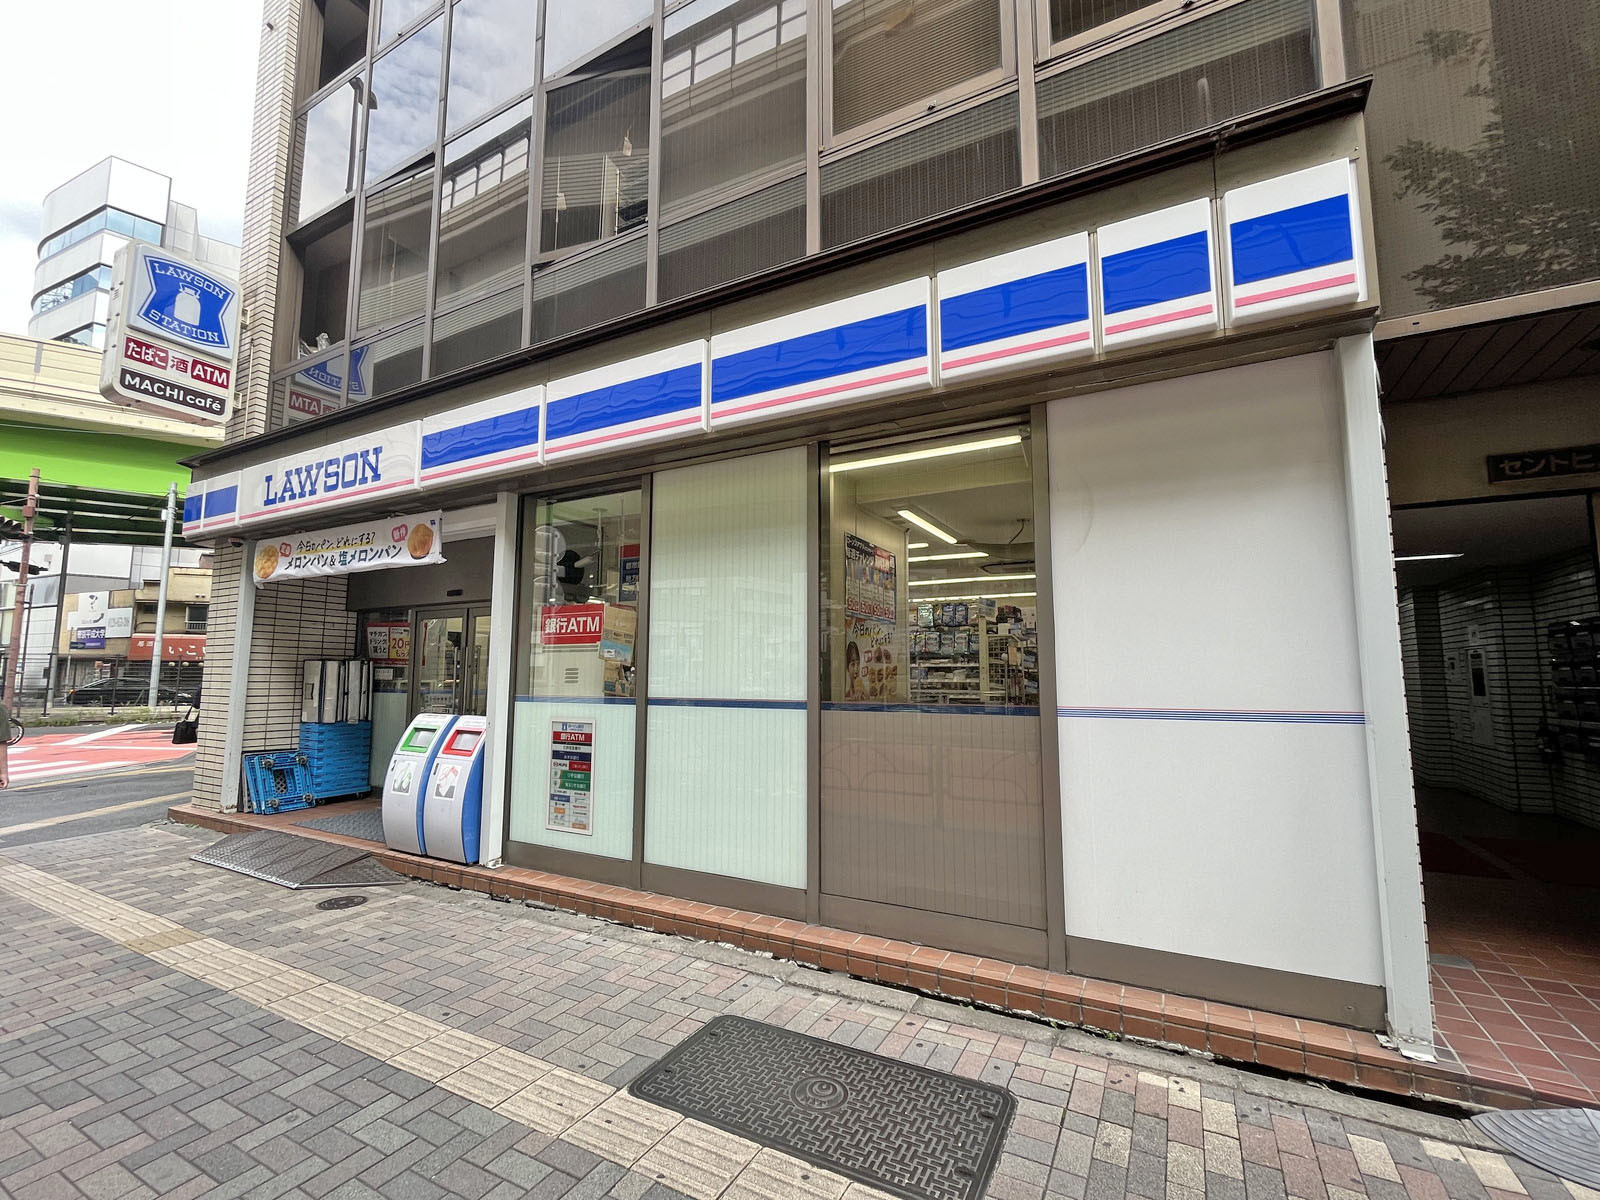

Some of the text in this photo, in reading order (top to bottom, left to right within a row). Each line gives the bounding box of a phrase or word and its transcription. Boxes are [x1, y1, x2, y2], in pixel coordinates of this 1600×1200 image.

[154, 262, 226, 300] LAWSON
[148, 308, 221, 343] STATION
[126, 340, 228, 386] たばこ 酒 ATM
[124, 373, 222, 412] MACHI café
[264, 446, 382, 505] LAWSON
[545, 615, 600, 634] 銀行ATM
